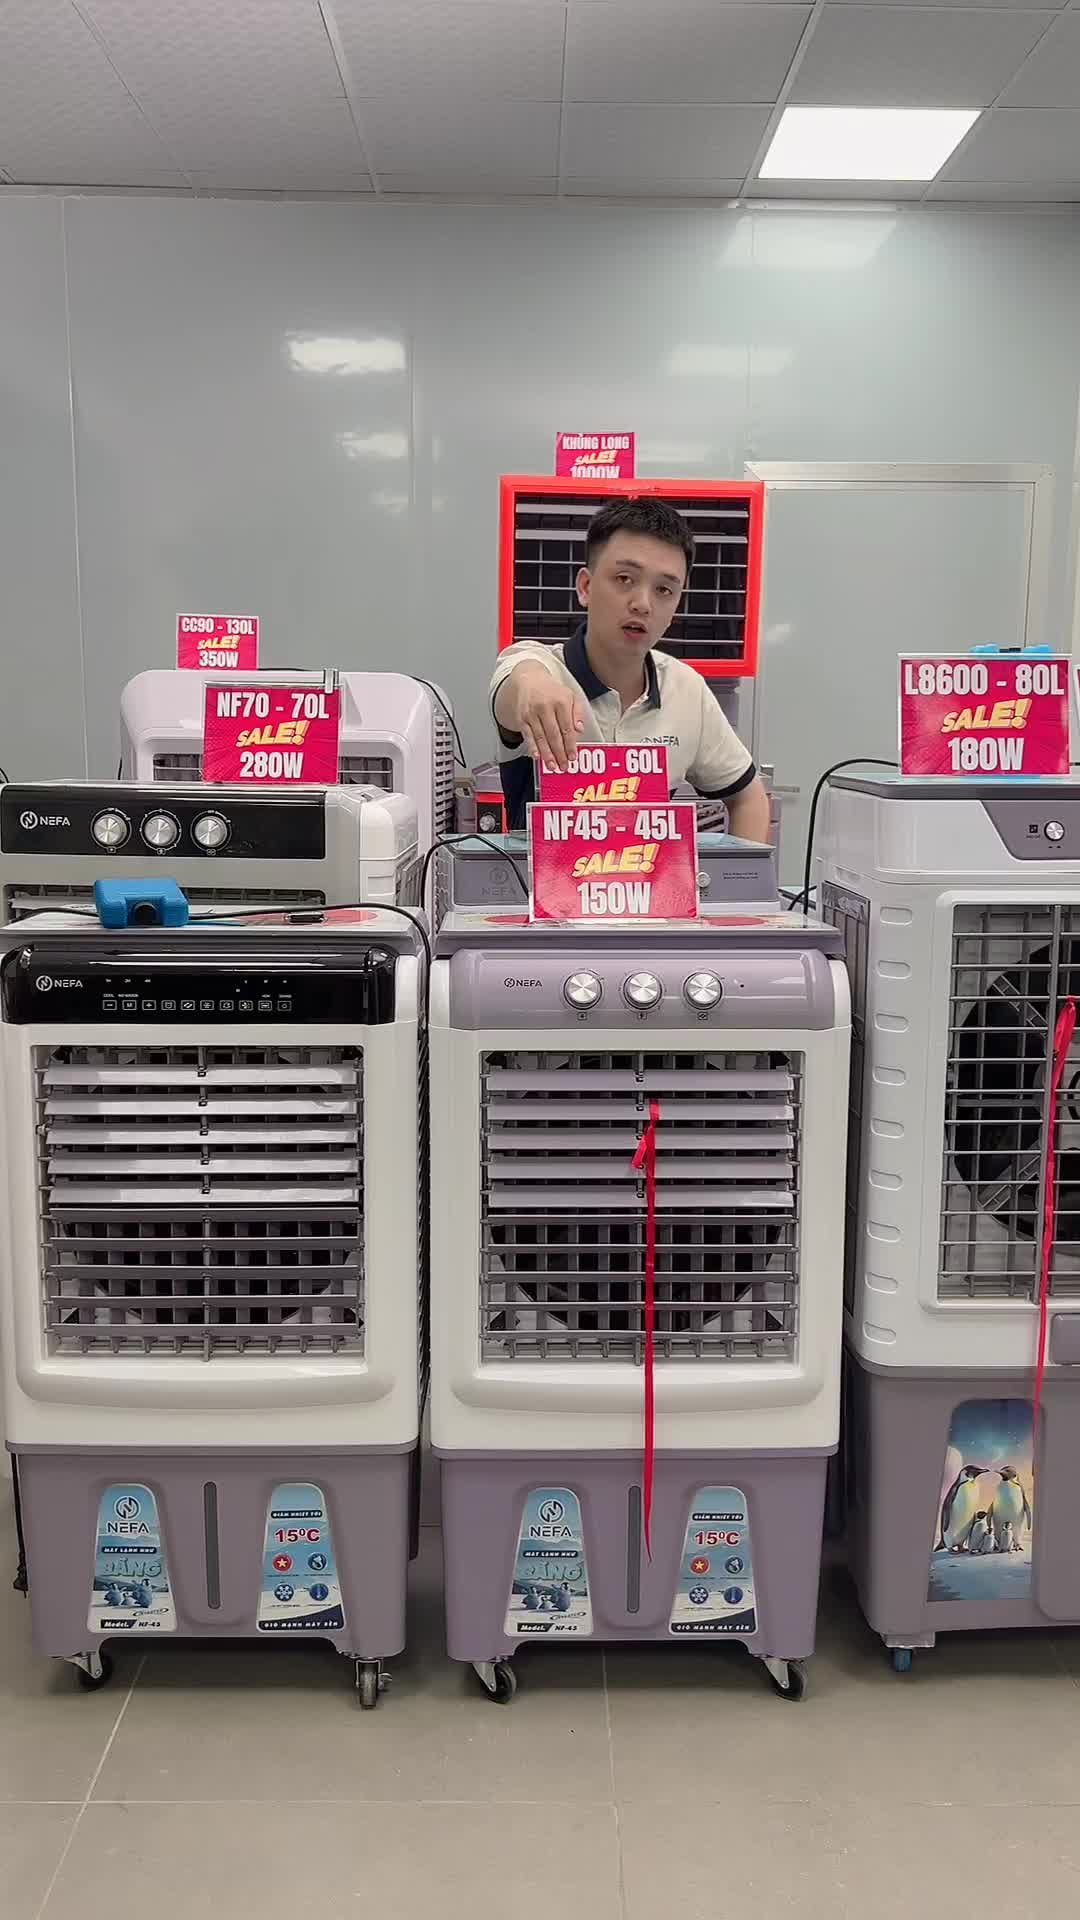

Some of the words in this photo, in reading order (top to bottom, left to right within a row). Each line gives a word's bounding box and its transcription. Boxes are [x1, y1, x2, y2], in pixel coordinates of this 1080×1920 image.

[601, 436, 630, 450] LONG
[569, 465, 620, 479] 1000W
[181, 617, 214, 634] CC90
[226, 619, 255, 635] 130L
[197, 635, 240, 650] SALE!
[199, 651, 239, 668] 350W
[904, 663, 989, 696] L8600
[1014, 663, 1065, 696] 80L
[217, 692, 270, 718] NF70
[291, 693, 330, 719] 70L
[941, 698, 1033, 733] SALE!
[235, 720, 311, 748] SALE!
[239, 751, 304, 779] 280W
[625, 748, 663, 774] 60L
[947, 736, 1025, 771] 180W
[572, 776, 641, 802] SALE!
[39, 816, 71, 827] NEFA
[543, 809, 608, 841] NF45
[634, 810, 682, 841] 45L
[571, 843, 661, 878] SALE!
[576, 881, 652, 915] 150W
[54, 979, 83, 989] NEFA
[516, 979, 543, 988] NEFA
[107, 1521, 150, 1534] NEFA
[530, 1526, 572, 1537] NEFA
